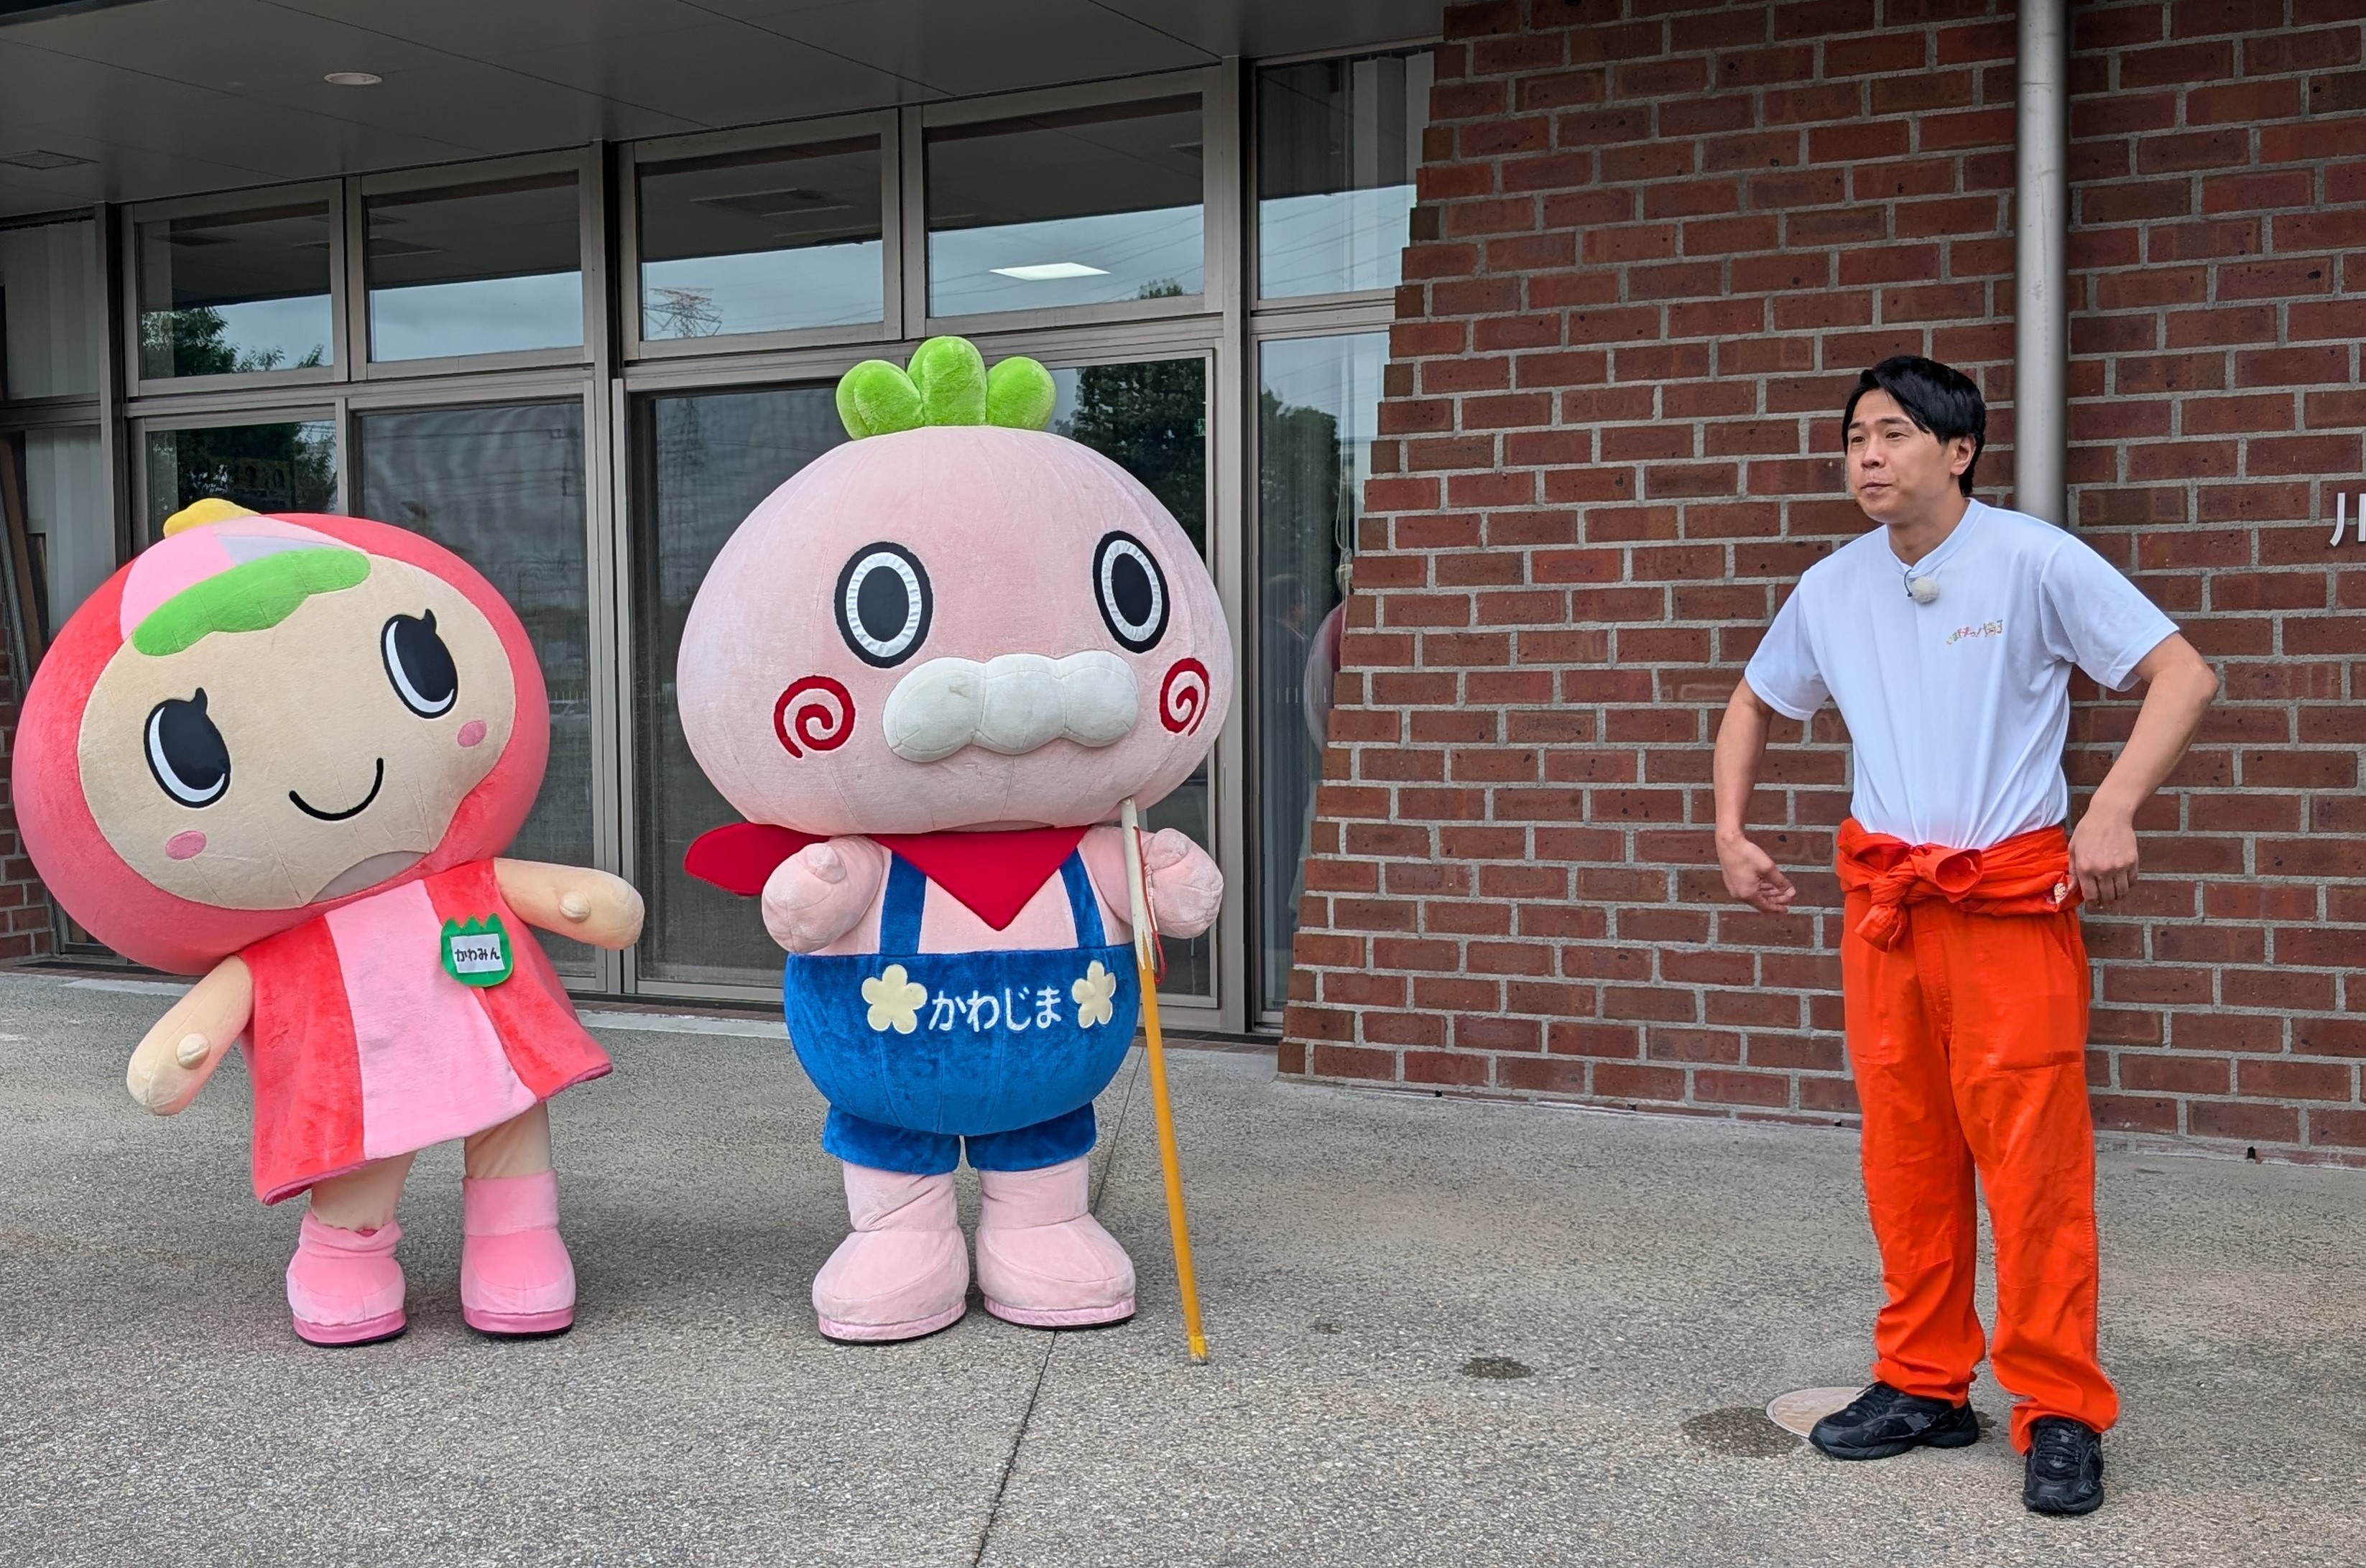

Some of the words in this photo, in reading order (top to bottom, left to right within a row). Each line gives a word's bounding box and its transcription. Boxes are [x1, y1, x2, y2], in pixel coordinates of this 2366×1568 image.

[454, 947, 501, 962] かわみん
[928, 985, 1062, 1032] かわじま
